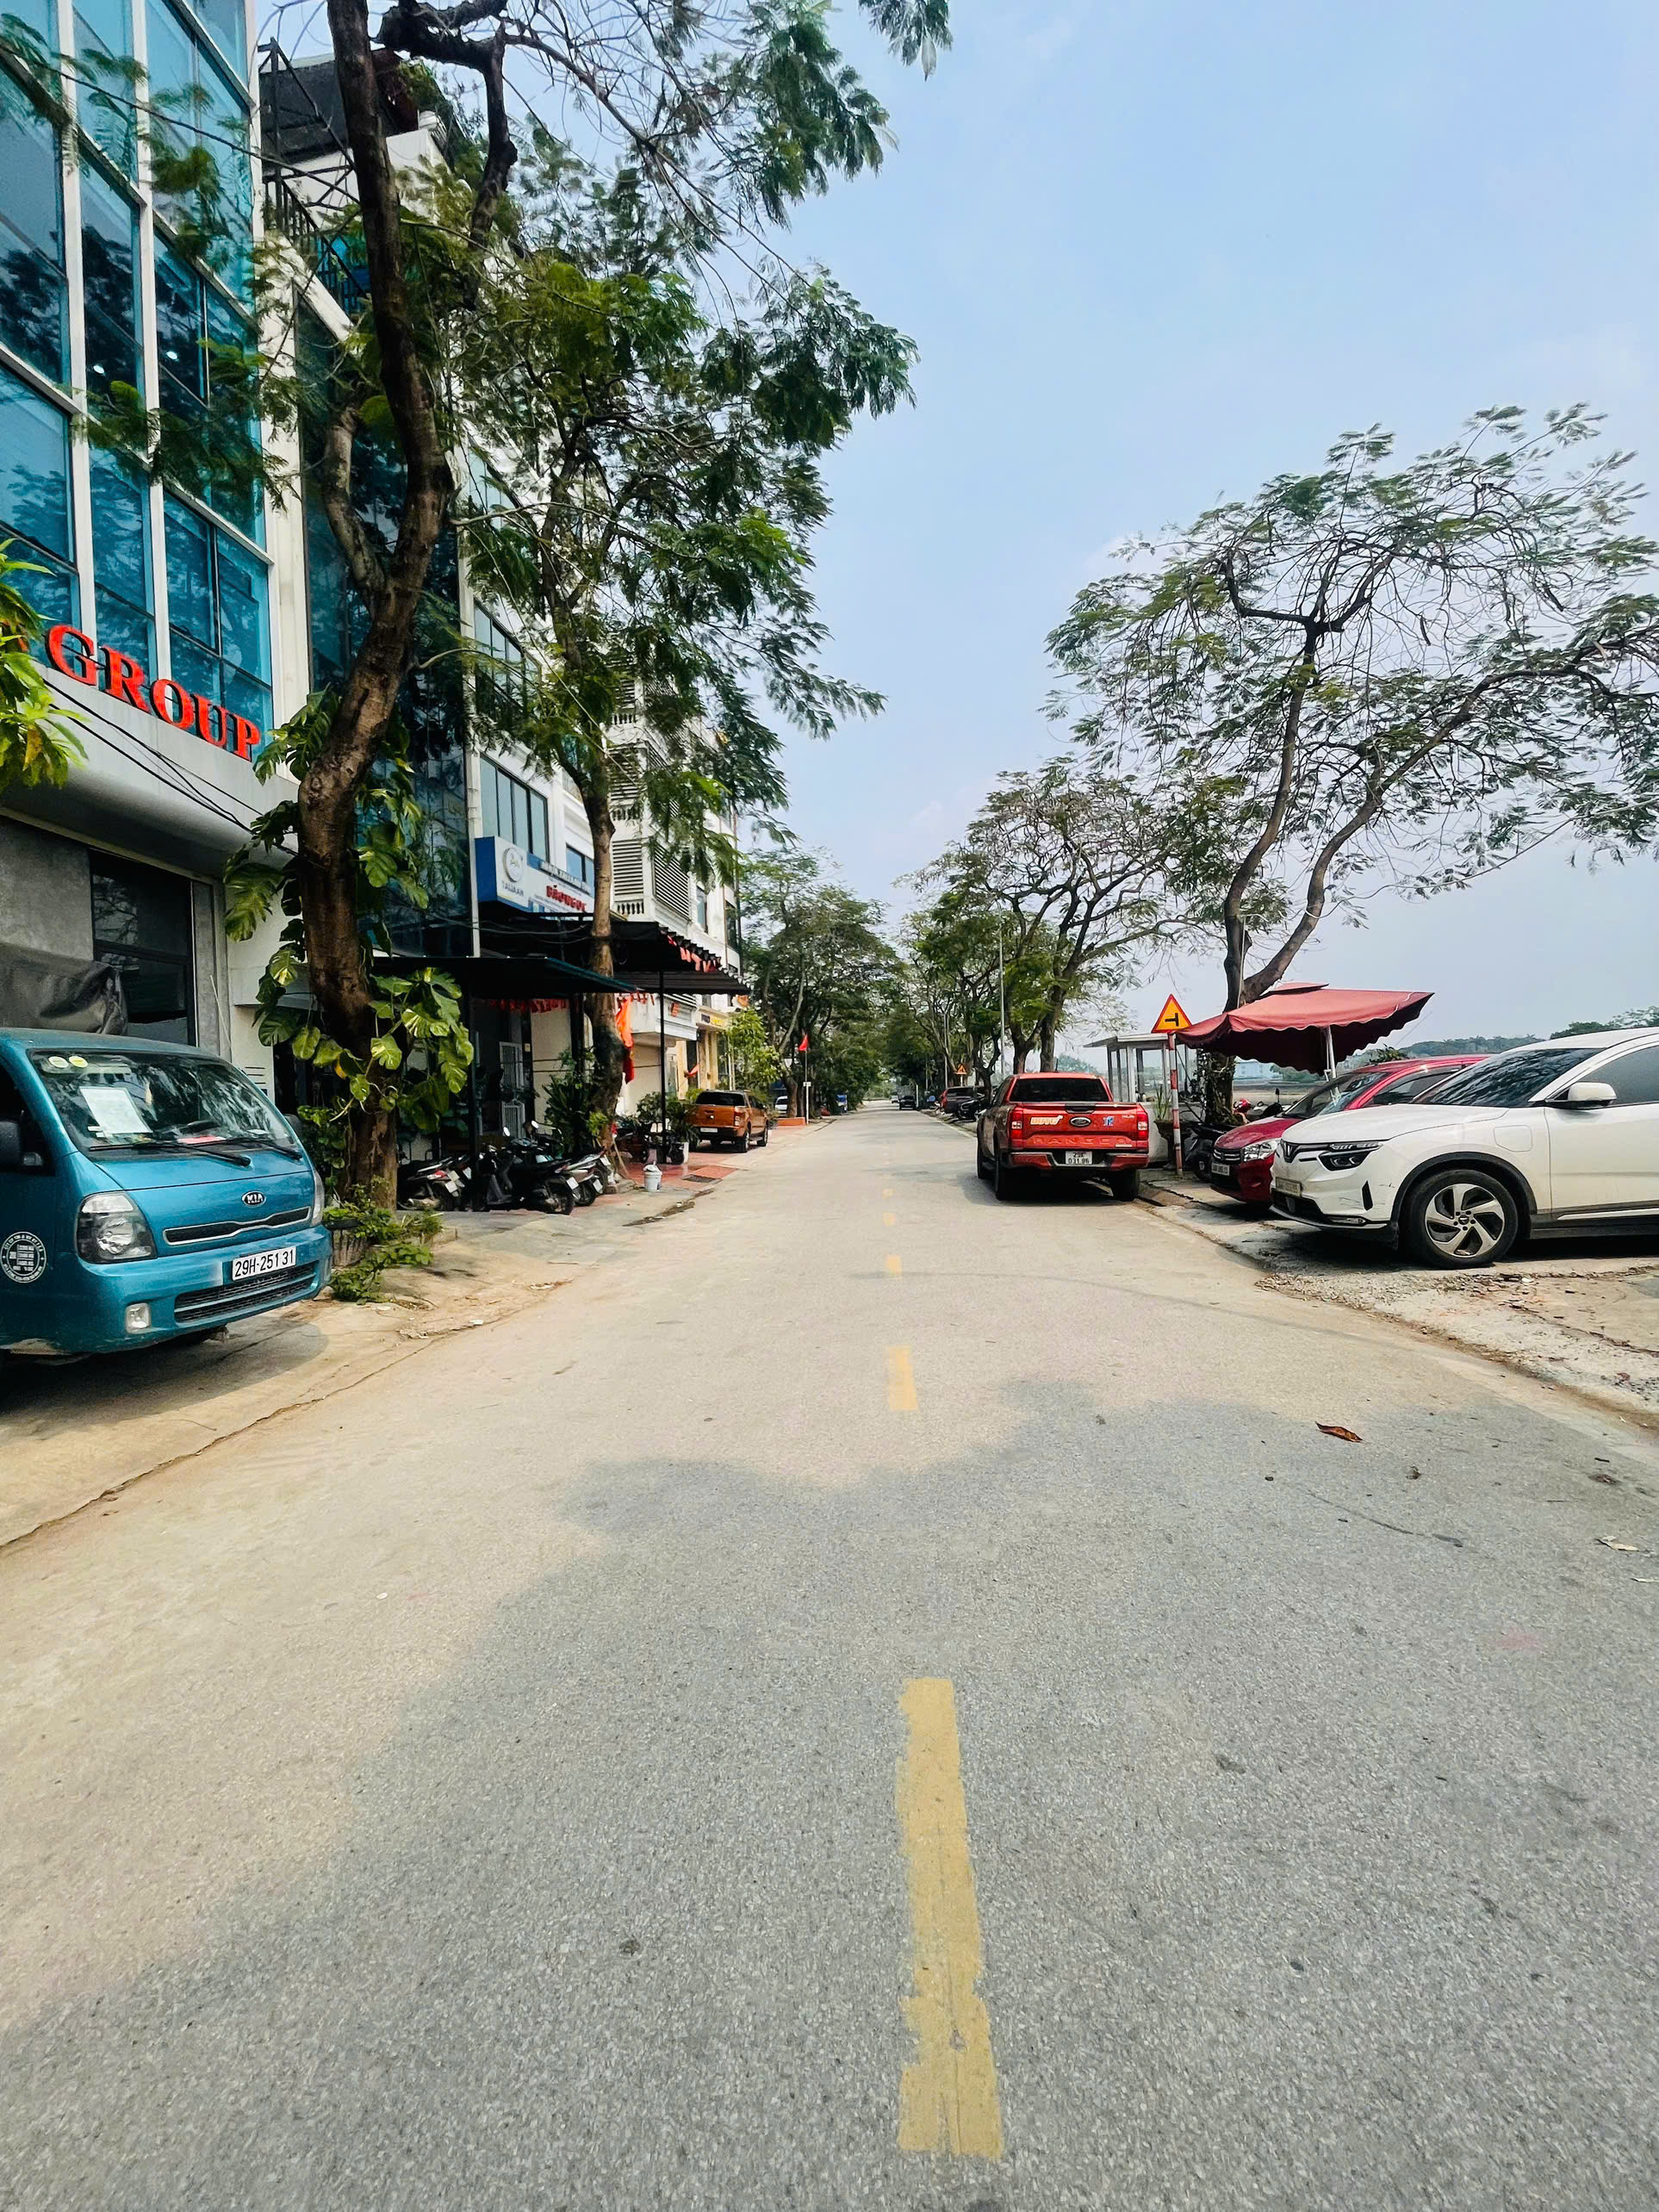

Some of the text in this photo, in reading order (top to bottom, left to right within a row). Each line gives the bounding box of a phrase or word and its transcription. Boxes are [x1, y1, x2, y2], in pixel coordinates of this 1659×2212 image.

[46, 624, 261, 762] GROUP
[1033, 1136, 1127, 1146] RANGER
[245, 1193, 264, 1204] KIA
